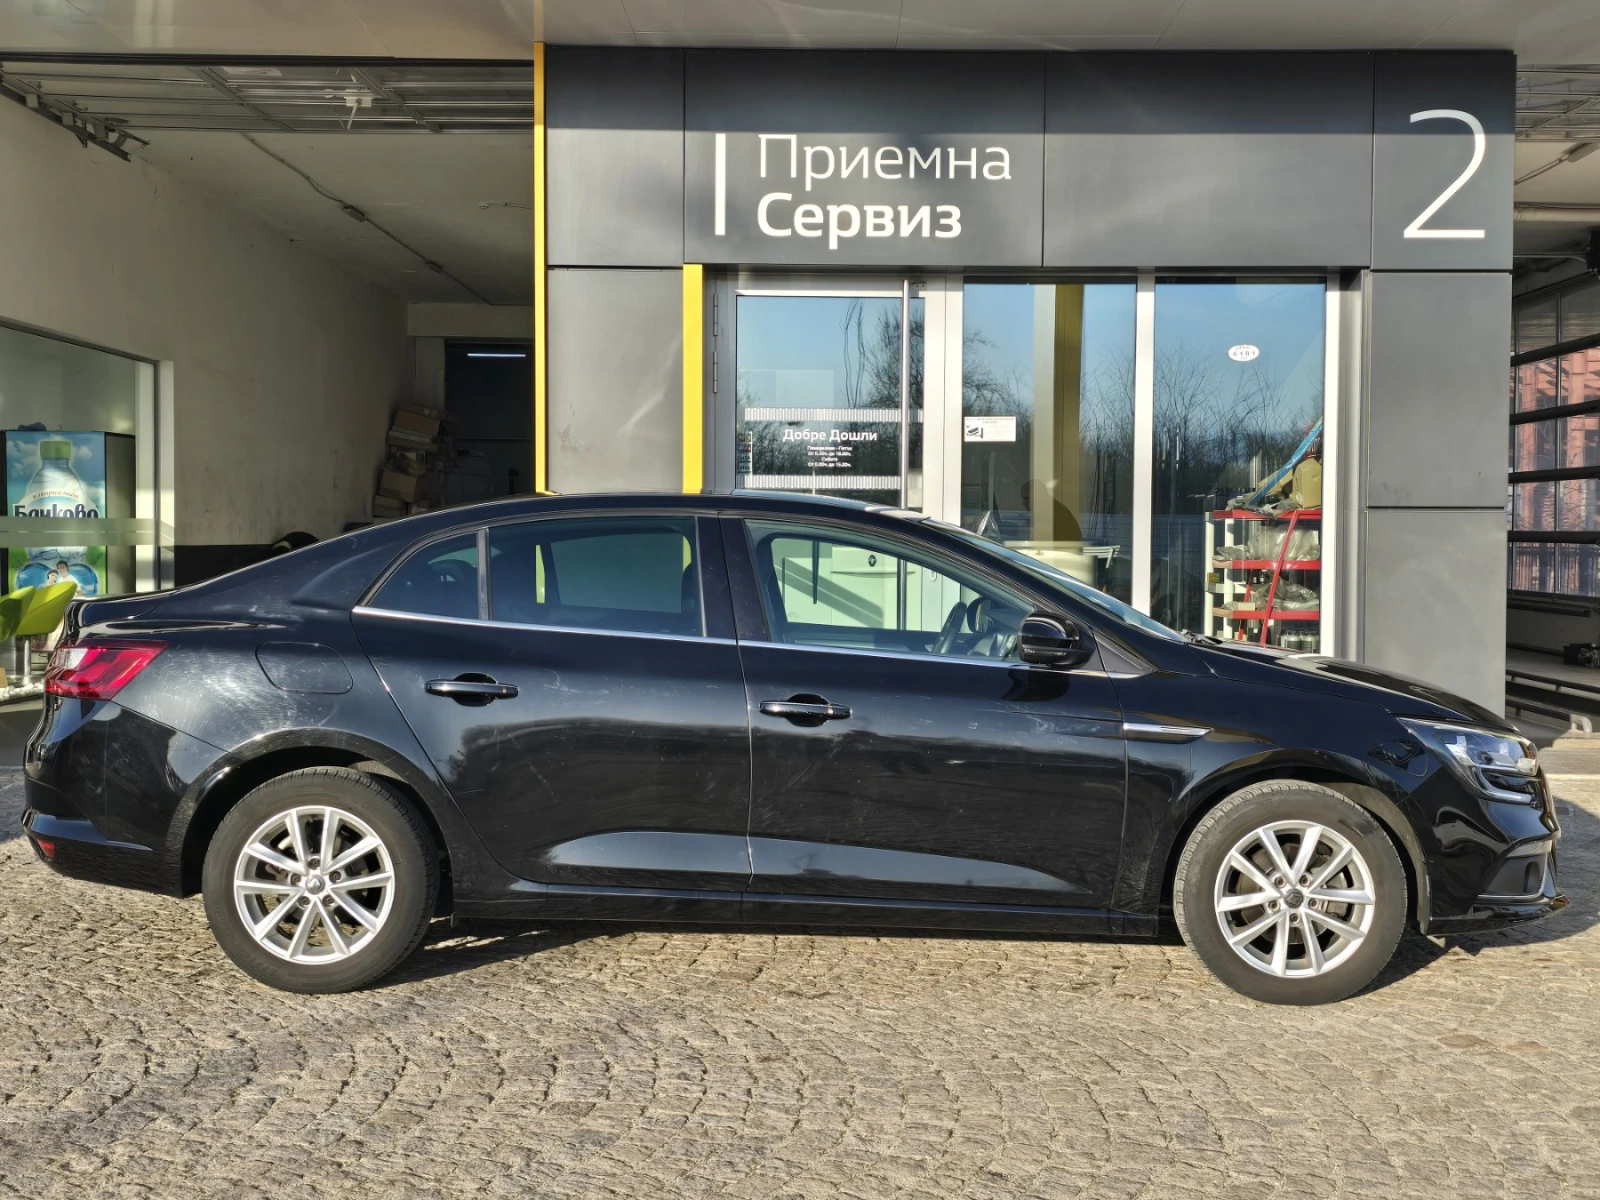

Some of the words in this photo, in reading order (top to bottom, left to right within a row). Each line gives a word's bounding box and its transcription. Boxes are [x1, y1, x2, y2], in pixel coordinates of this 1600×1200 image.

[758, 133, 1012, 192] Приемна
[1403, 109, 1486, 238] 2
[757, 192, 962, 250] Сервиз
[782, 428, 826, 442] Добре
[829, 429, 878, 442] Дошли
